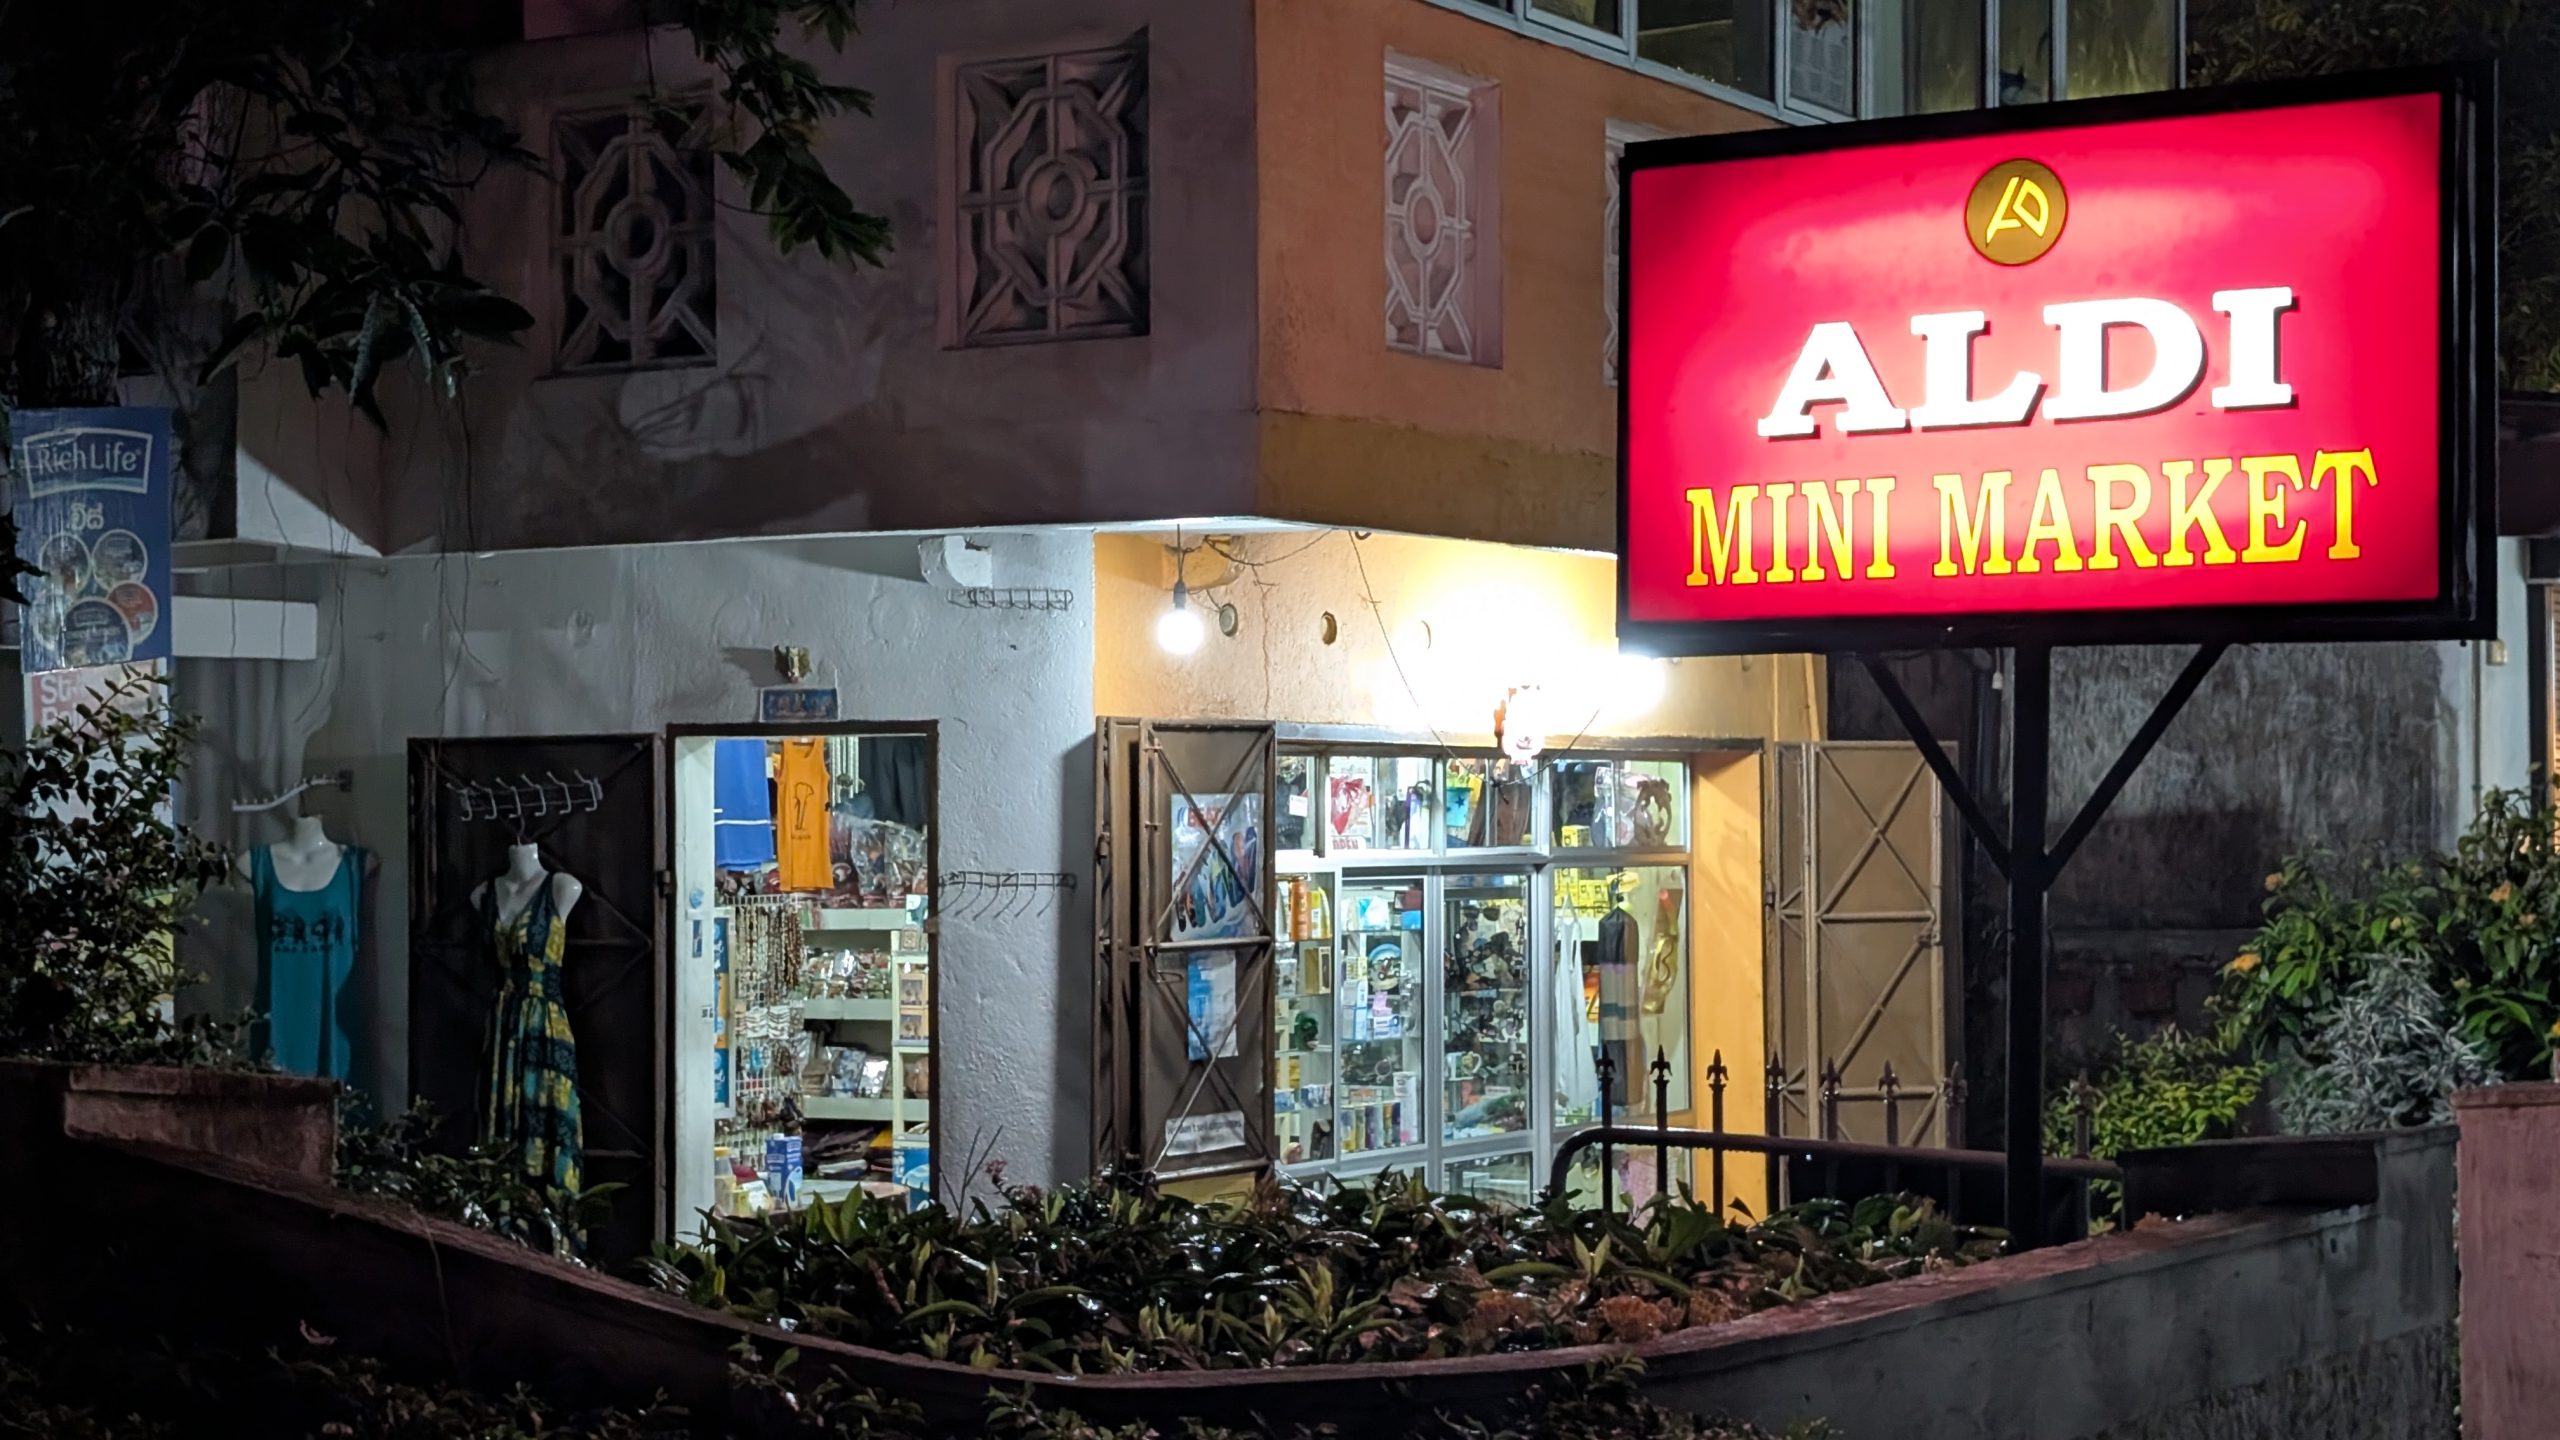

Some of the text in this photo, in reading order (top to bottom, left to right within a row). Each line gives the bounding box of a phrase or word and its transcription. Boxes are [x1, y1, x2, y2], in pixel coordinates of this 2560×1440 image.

[1757, 286, 2300, 440] ALDI
[38, 441, 138, 475] RichLife
[1685, 447, 2379, 588] MINI MARKET
